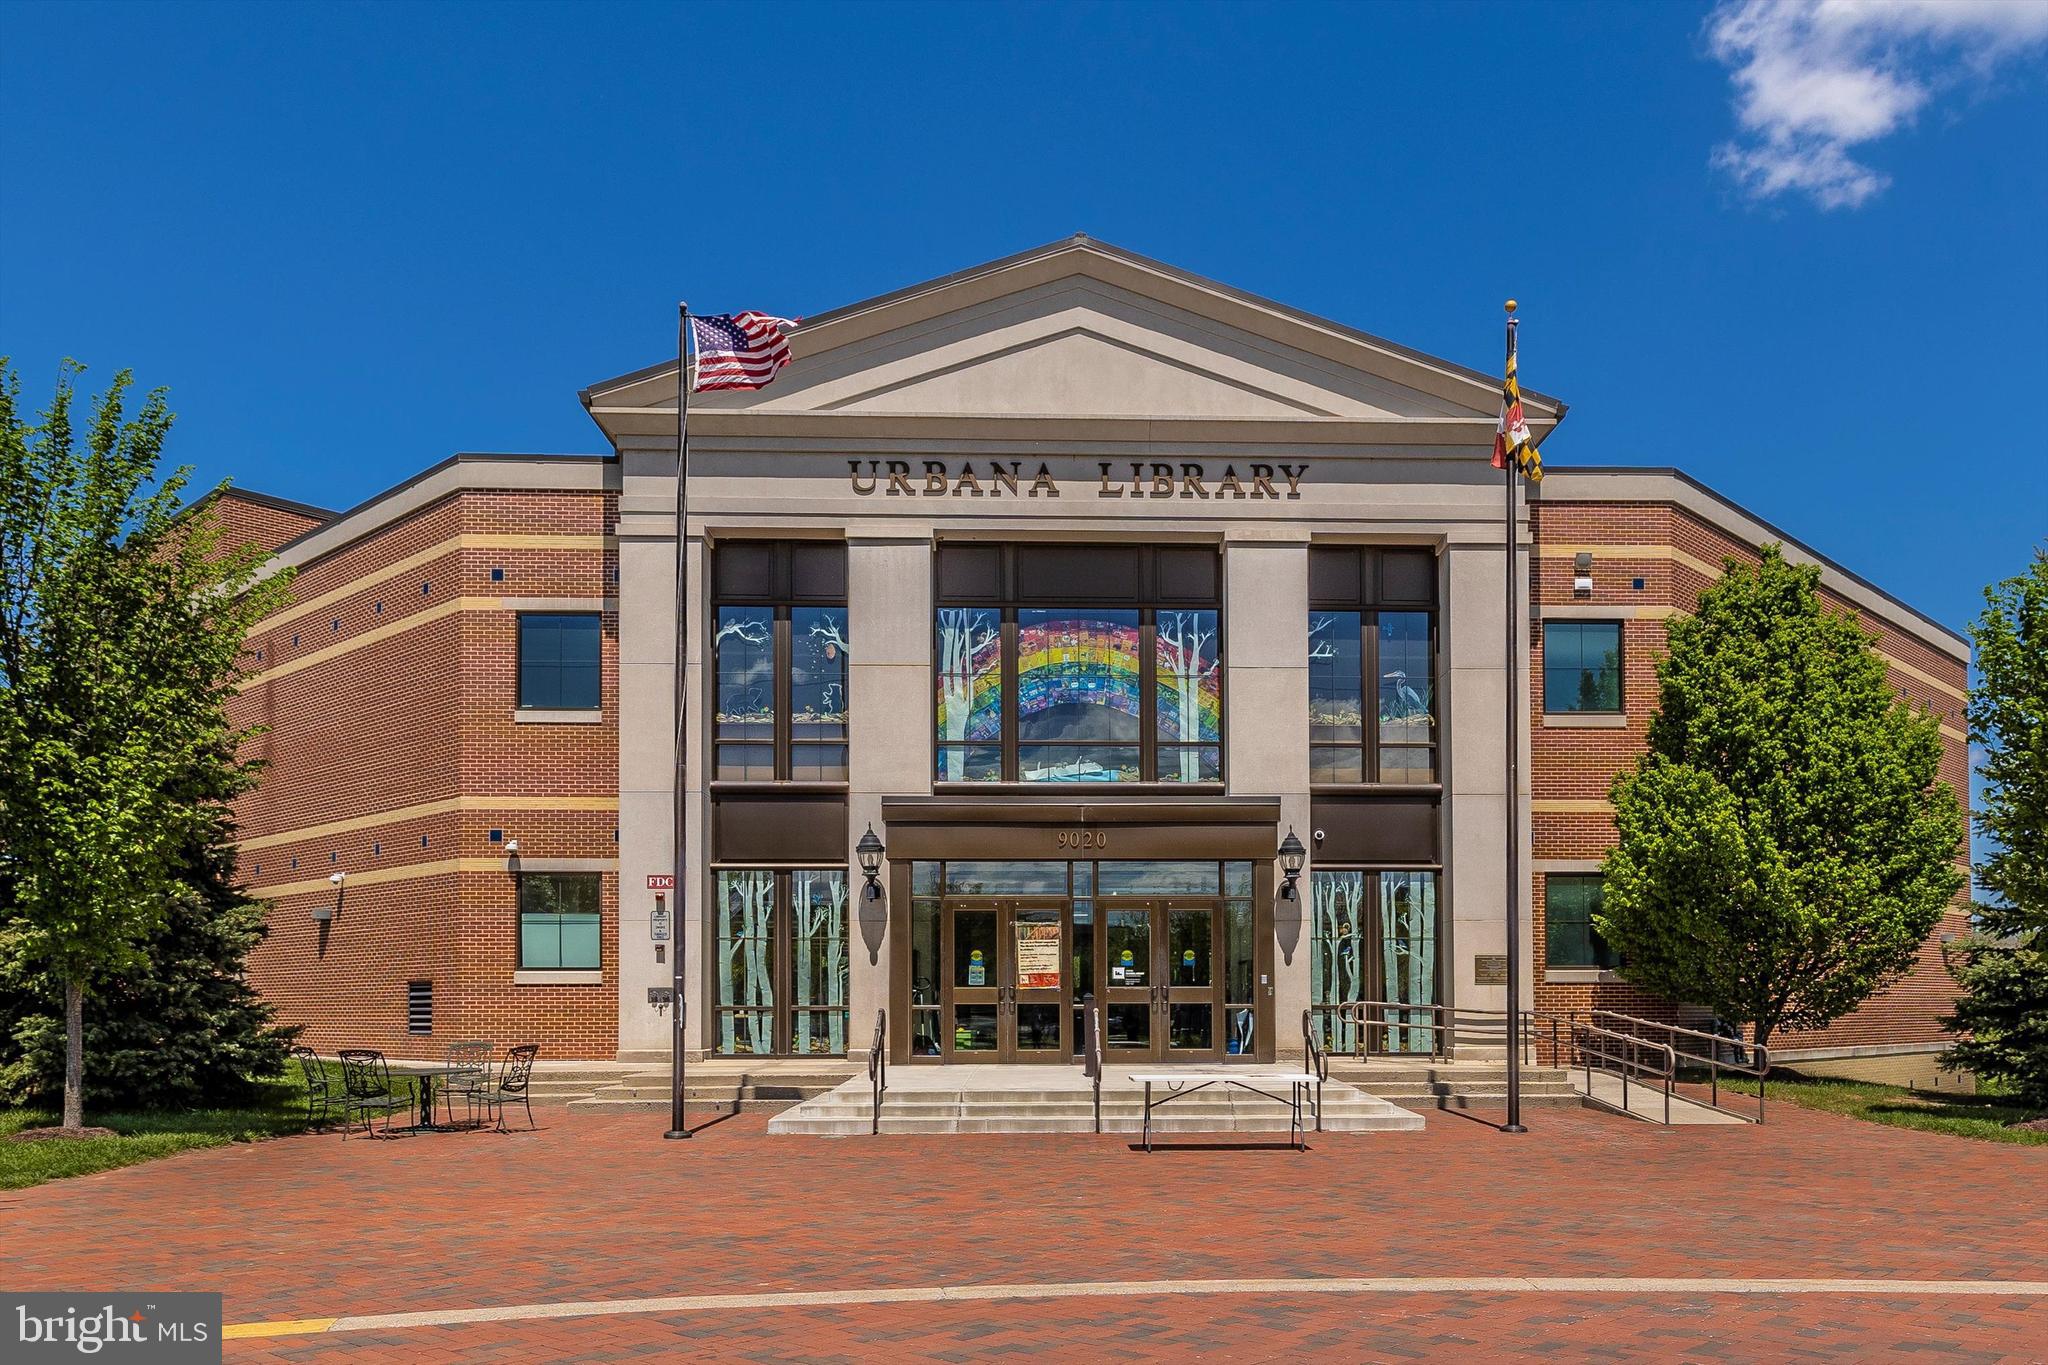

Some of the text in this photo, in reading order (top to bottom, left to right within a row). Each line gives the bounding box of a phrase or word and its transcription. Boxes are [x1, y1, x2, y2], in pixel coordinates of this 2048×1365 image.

[847, 460, 1310, 499] URBANA LIBRARY
[1058, 831, 1107, 848] 9020
[649, 877, 674, 887] FDC
